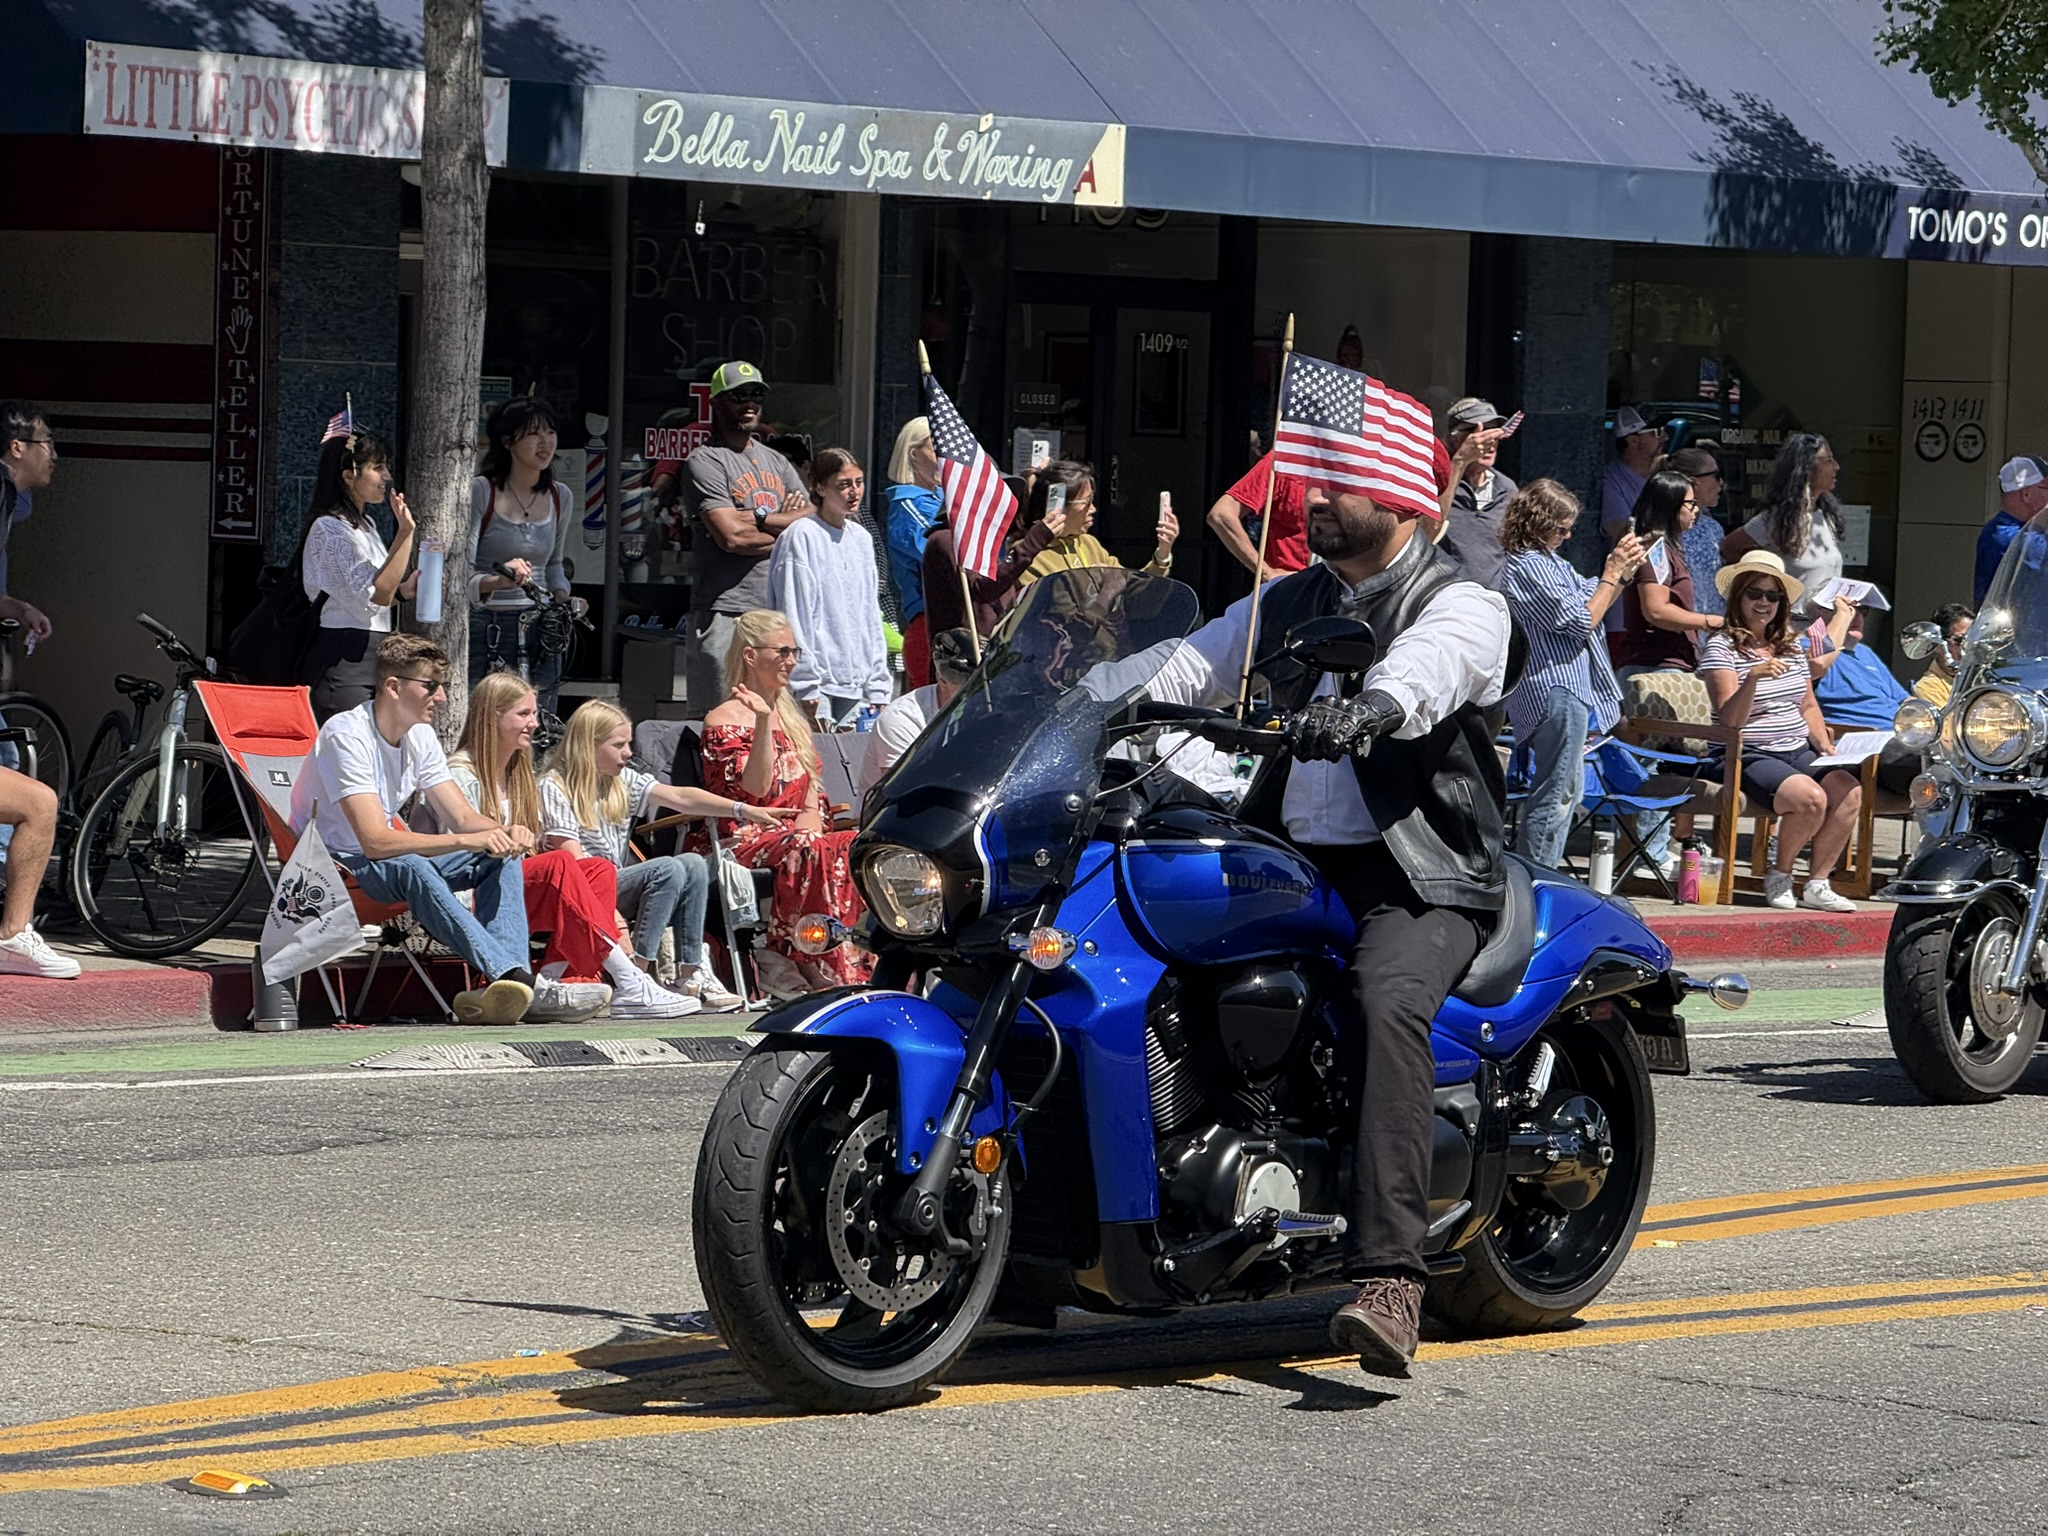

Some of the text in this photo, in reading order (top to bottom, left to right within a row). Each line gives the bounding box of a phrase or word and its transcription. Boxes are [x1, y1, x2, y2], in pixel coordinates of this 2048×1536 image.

[103, 61, 233, 135] LITTLE
[240, 73, 390, 148] PSYCHIC
[642, 99, 1073, 203] Bella Nail Spa & Waxing
[1907, 206, 2009, 247] TOMO'S
[631, 236, 827, 305] BARBER
[662, 312, 797, 380] SHOP
[1139, 332, 1174, 353] 1409
[1020, 393, 1056, 405] CLOSED
[224, 359, 248, 513] TELLER
[1721, 428, 1758, 444] ORGANIC
[731, 470, 759, 503] NEW
